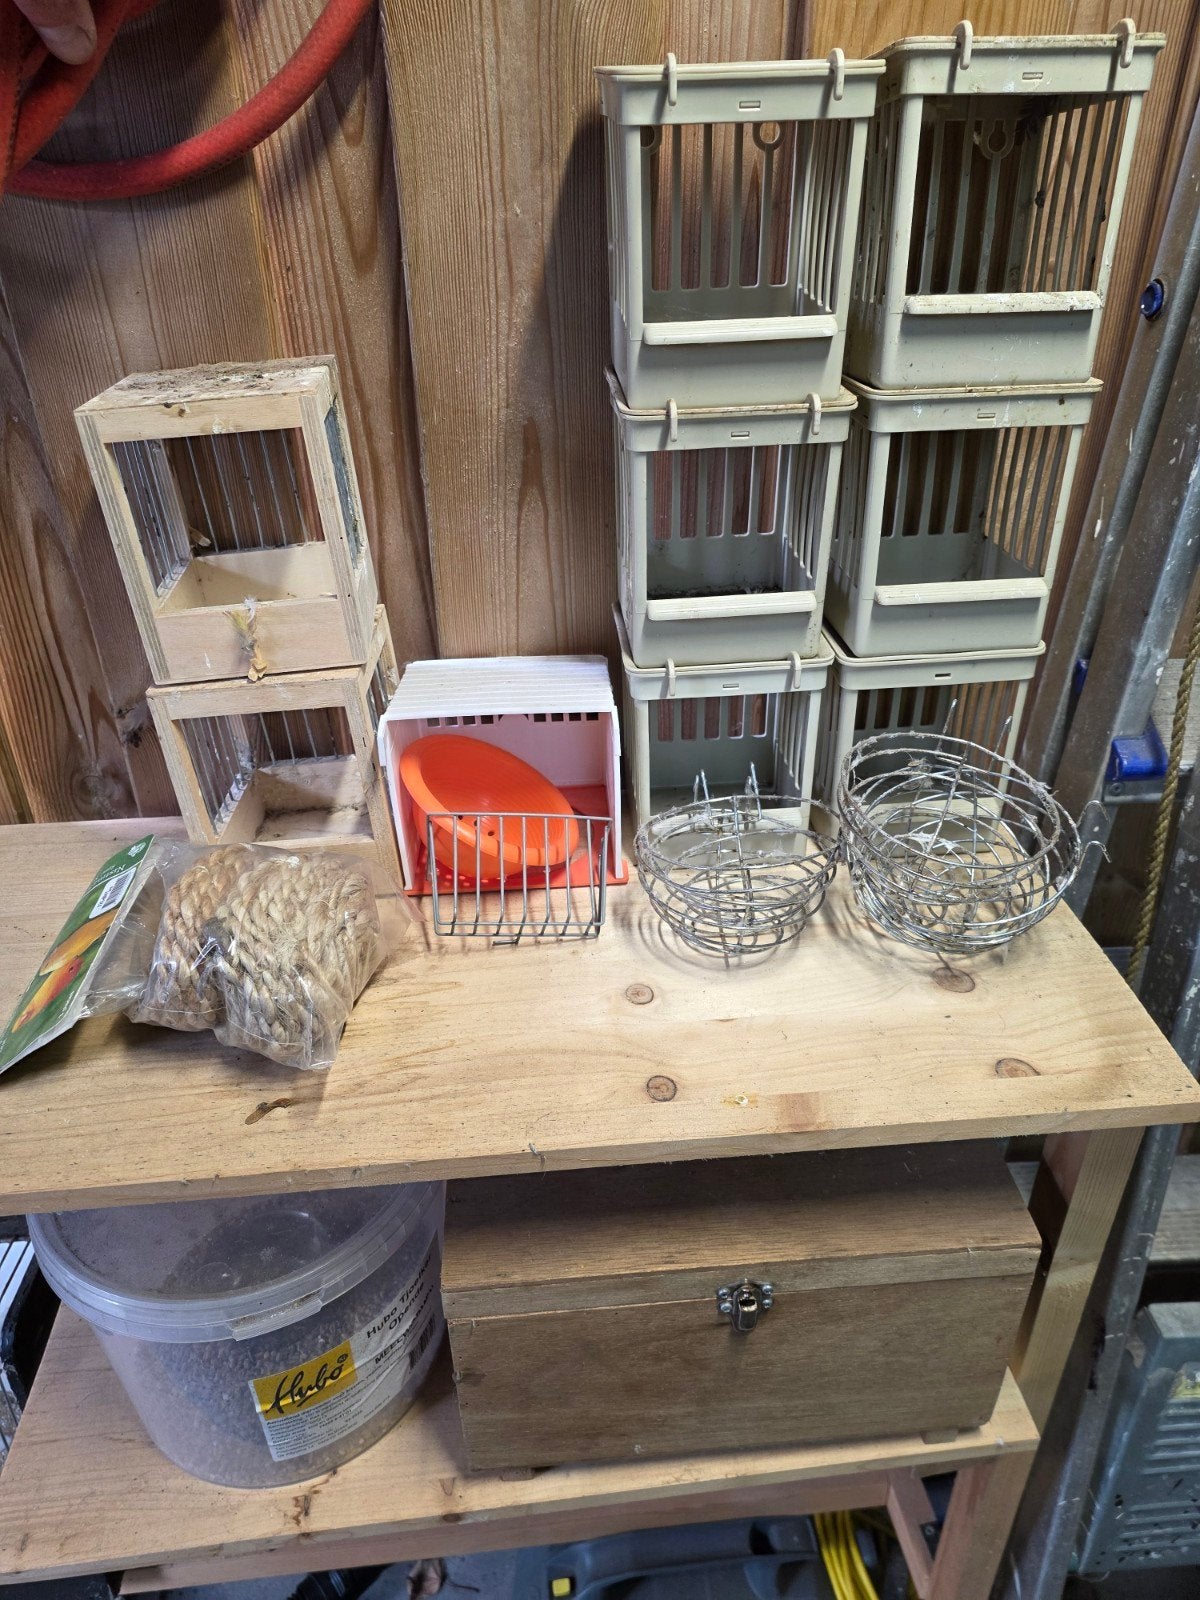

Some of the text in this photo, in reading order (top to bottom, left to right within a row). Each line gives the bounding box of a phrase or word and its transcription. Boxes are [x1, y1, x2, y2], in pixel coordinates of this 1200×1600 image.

[366, 1307, 397, 1339] Hubo
[389, 1281, 424, 1330] Opende
[266, 1363, 344, 1414] Hubo
